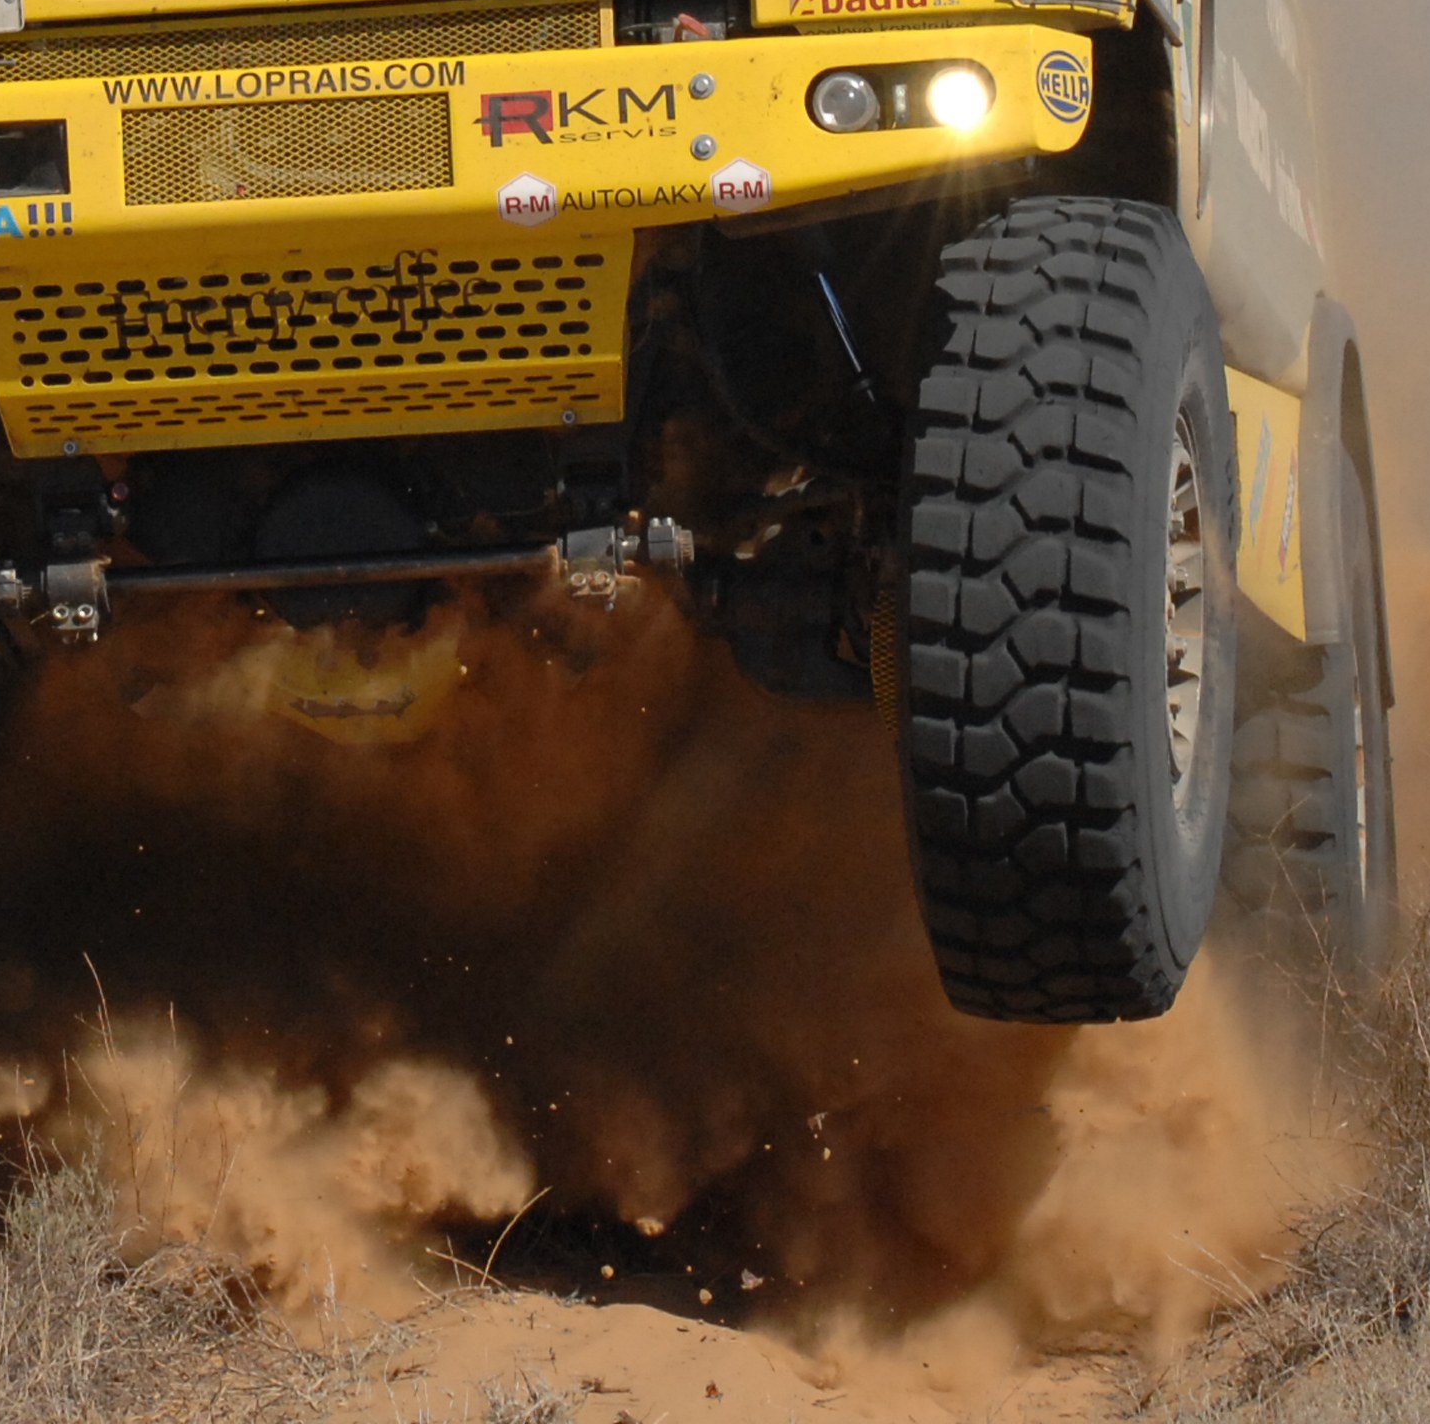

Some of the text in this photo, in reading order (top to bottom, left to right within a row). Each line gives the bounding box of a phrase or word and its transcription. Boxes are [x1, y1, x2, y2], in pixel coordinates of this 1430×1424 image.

[102, 60, 467, 105] WWW.LOPRAIS.COM
[1041, 71, 1090, 107] HELLA
[473, 84, 676, 148] RKM
[559, 117, 678, 144] servis
[504, 180, 764, 215] R-M AUTOLAKY R-M
